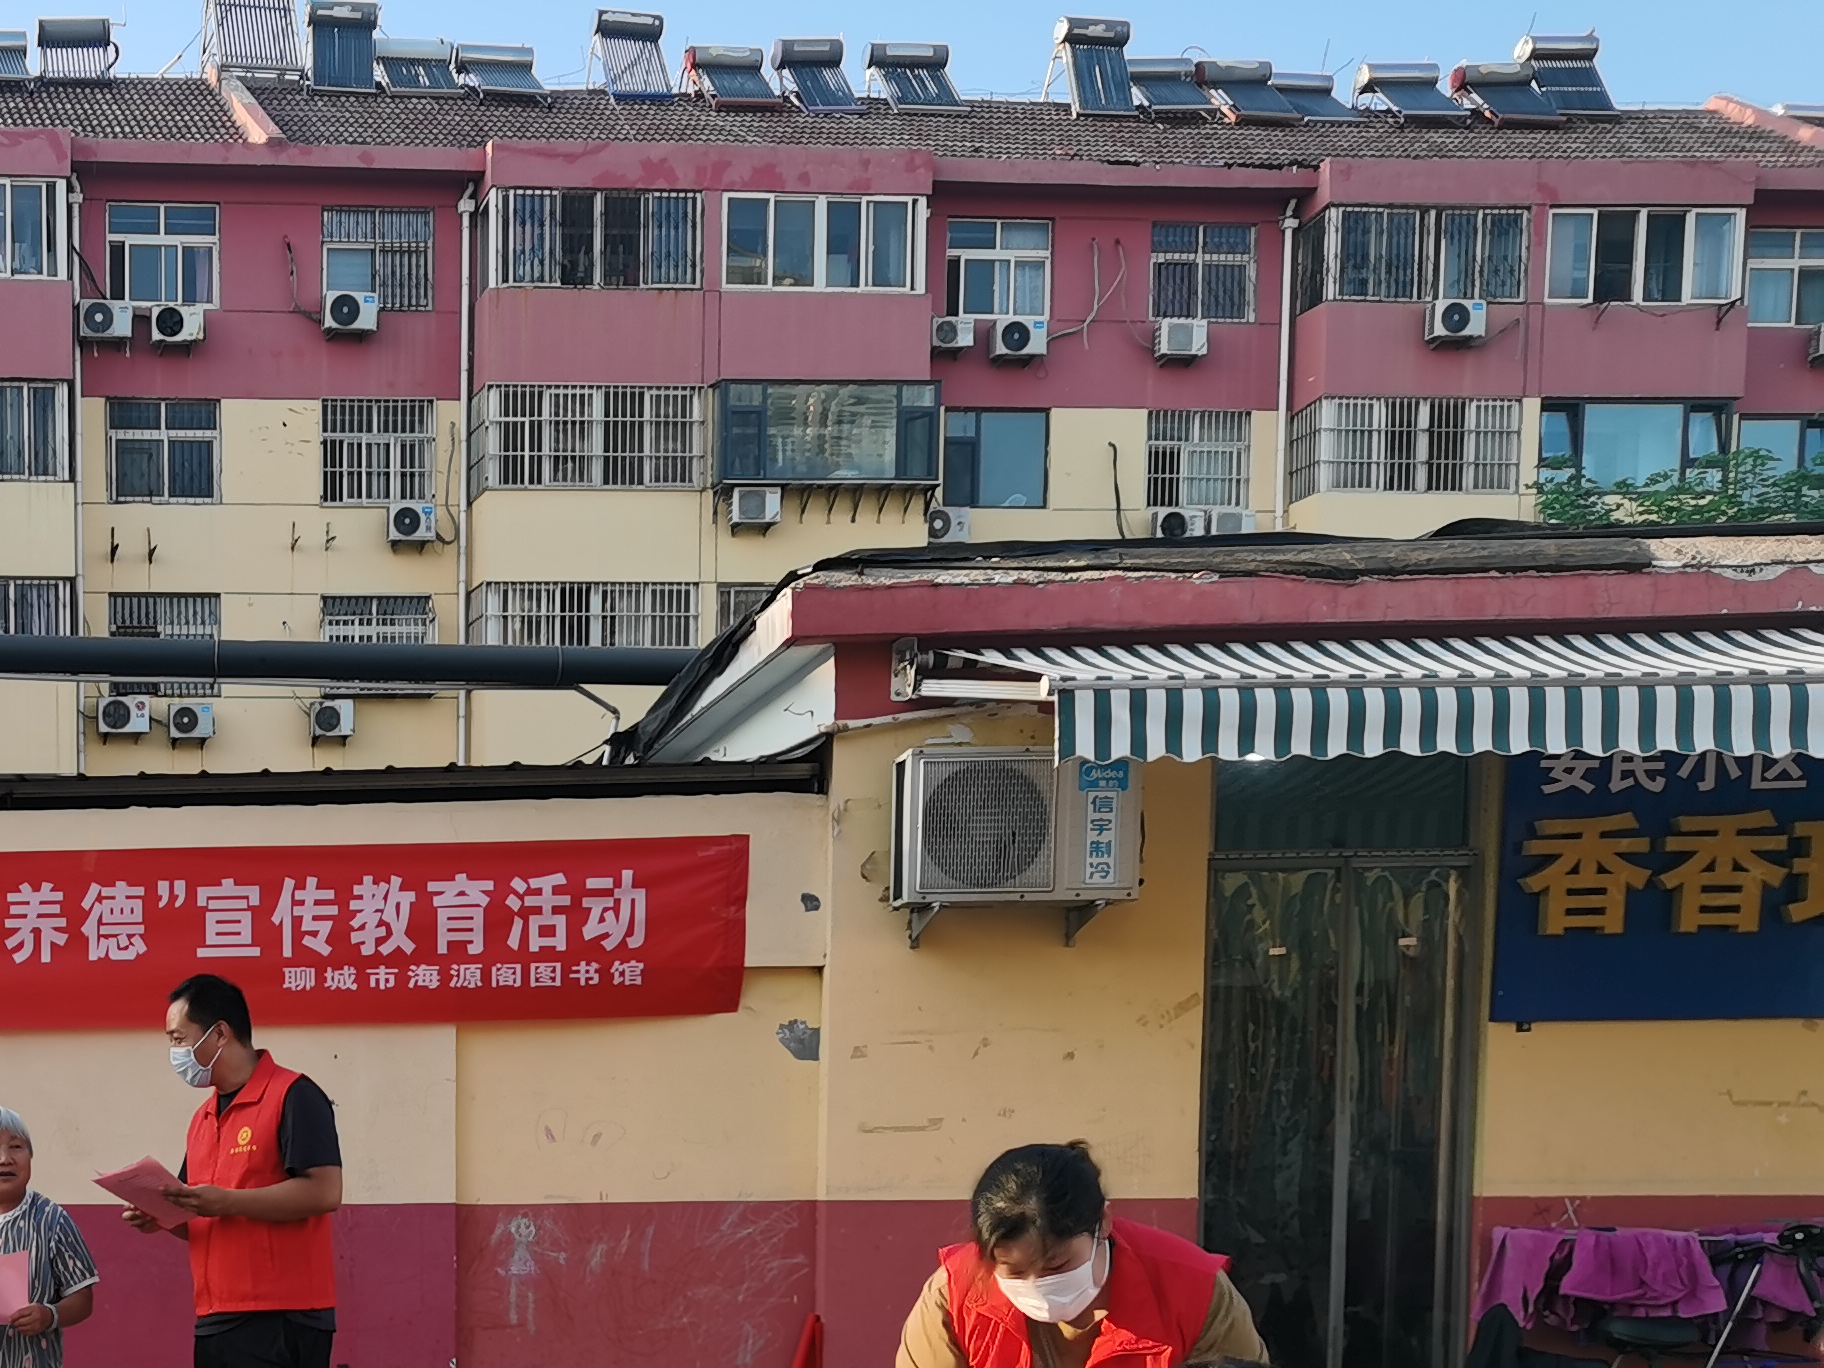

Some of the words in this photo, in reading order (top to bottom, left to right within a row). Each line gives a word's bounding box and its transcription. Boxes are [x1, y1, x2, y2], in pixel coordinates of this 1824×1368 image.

[282, 960, 646, 992] 聊城市海源阁图书馆
